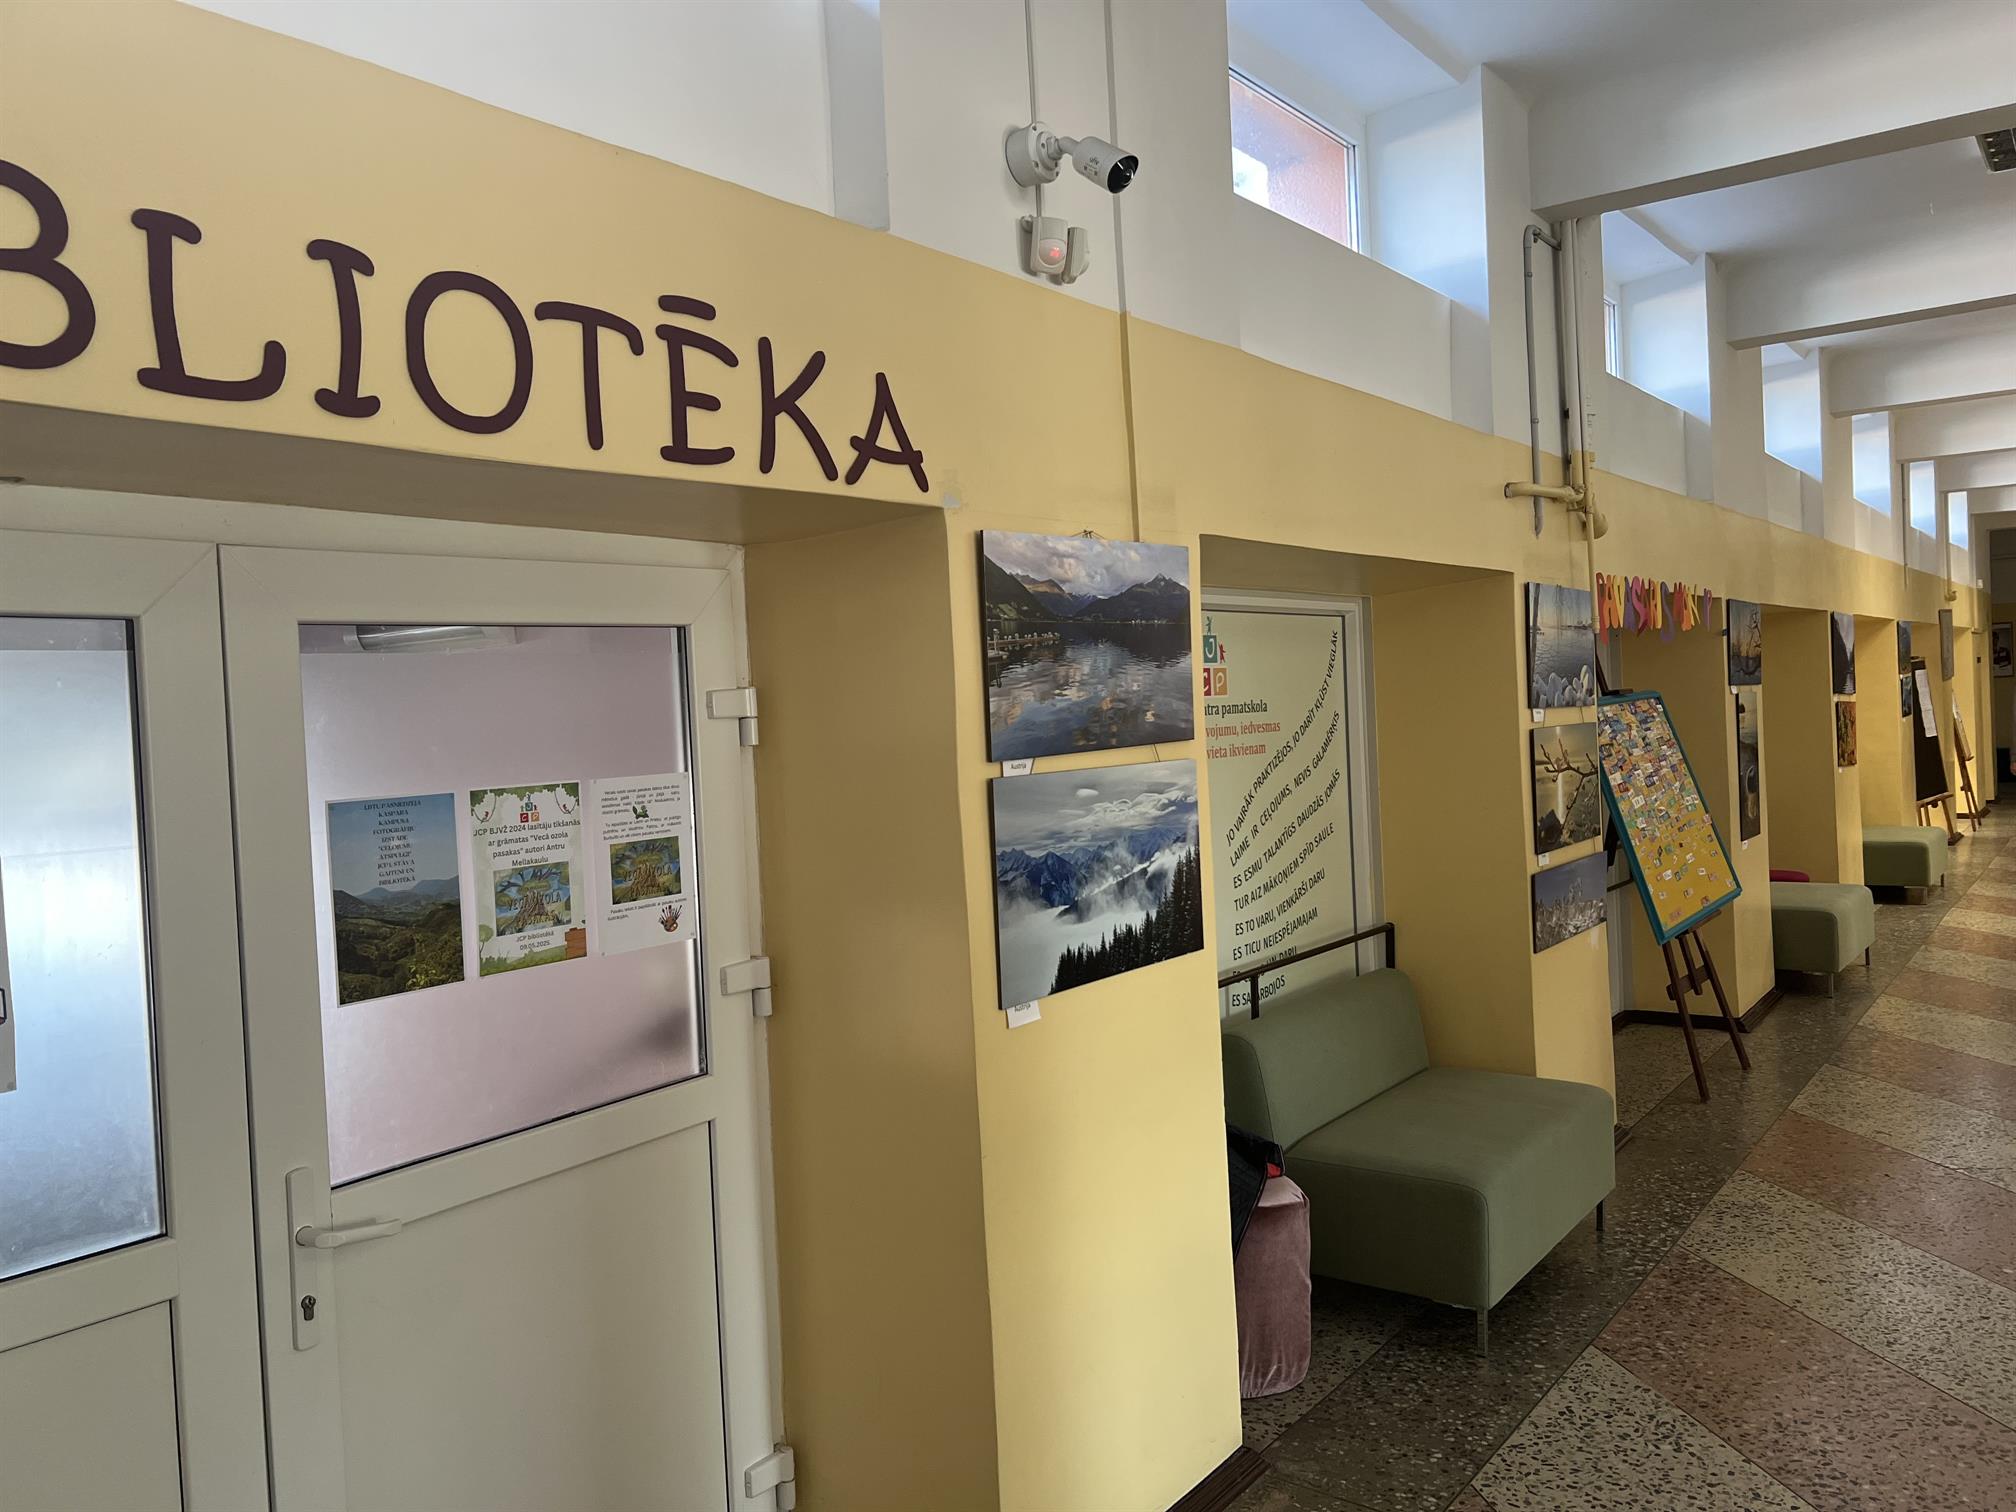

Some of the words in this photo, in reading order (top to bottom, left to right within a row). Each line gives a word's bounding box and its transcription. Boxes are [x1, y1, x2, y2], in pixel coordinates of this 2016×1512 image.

[1221, 699, 1268, 718] pamatskola
[1205, 723, 1239, 741] vojumu,
[1240, 720, 1281, 735] iedvesmas
[1226, 828, 1235, 847] JO
[1234, 789, 1255, 832] VAIRĀK
[1252, 740, 1294, 794] PRAKTIZĒJOS,
[1292, 731, 1300, 748] JO
[1300, 708, 1317, 737] DARĪT
[1315, 679, 1330, 712] KĻŪST
[1326, 629, 1338, 679] VIEGLĀK
[1206, 744, 1228, 760] vieta
[1229, 743, 1266, 757] ikvienam
[1230, 835, 1251, 868] LAIME
[1250, 824, 1260, 840] IR
[1260, 784, 1293, 827] CEĻOJUMS,
[1293, 765, 1312, 789] NEVIS
[1312, 710, 1340, 770] GALAMĒRĶIS
[473, 829, 488, 837] JCP
[509, 824, 526, 833] 2024
[496, 836, 529, 848] grāmatas
[550, 831, 569, 840] ozola
[1233, 874, 1242, 889] ES
[1244, 857, 1263, 882] ESMU
[1262, 821, 1297, 864] TALANTĪGS
[1296, 795, 1324, 828] DAUDZĀS
[1324, 768, 1341, 803] JOMĀS
[492, 848, 524, 859] pasakas"
[524, 845, 545, 854] autori
[546, 843, 566, 852] Antru
[1234, 894, 1250, 912] TUR
[1250, 886, 1262, 904] AIZ
[1263, 857, 1301, 896] MĀKOŅIEM
[1299, 841, 1314, 865] SPĪD
[1314, 822, 1335, 848] SAULE
[1235, 922, 1244, 936] ES
[1245, 920, 1255, 934] TO
[1256, 910, 1276, 930] VARU,
[1276, 884, 1309, 917] VIENKĀRŠI
[1308, 867, 1326, 894] DARU
[1232, 946, 1242, 961] ES
[1244, 938, 1261, 956] TICU
[1263, 906, 1319, 949] NEIESPĒJAMAJAM
[1232, 994, 1241, 1007] ES
[1242, 974, 1286, 1006] SARBOJOS
